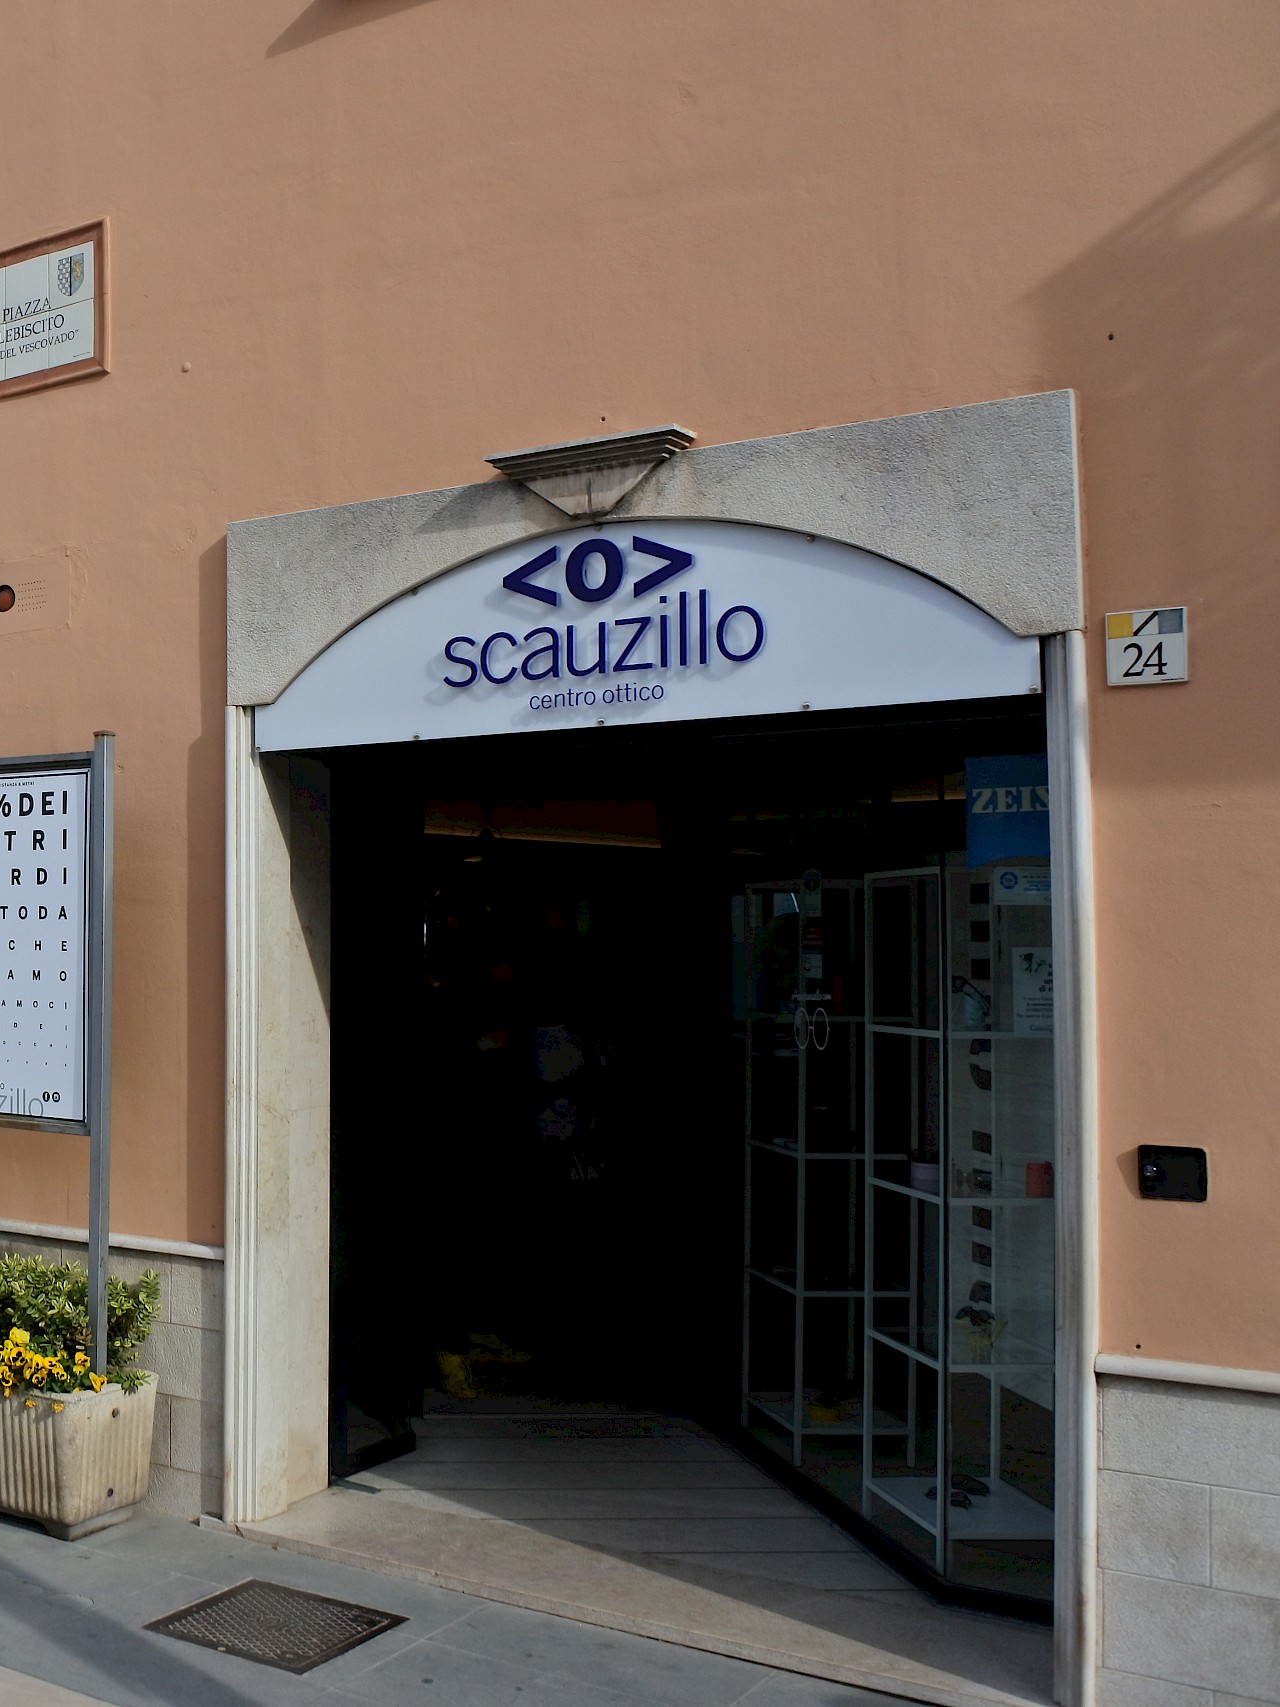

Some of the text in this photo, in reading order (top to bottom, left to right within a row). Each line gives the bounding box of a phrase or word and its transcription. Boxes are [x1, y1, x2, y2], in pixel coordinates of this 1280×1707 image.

[2, 297, 51, 322] PIAZZA
[0, 348, 17, 360] DEL
[442, 588, 765, 689] scauzillo
[1122, 641, 1167, 678] 24
[529, 682, 664, 710] centro ottico
